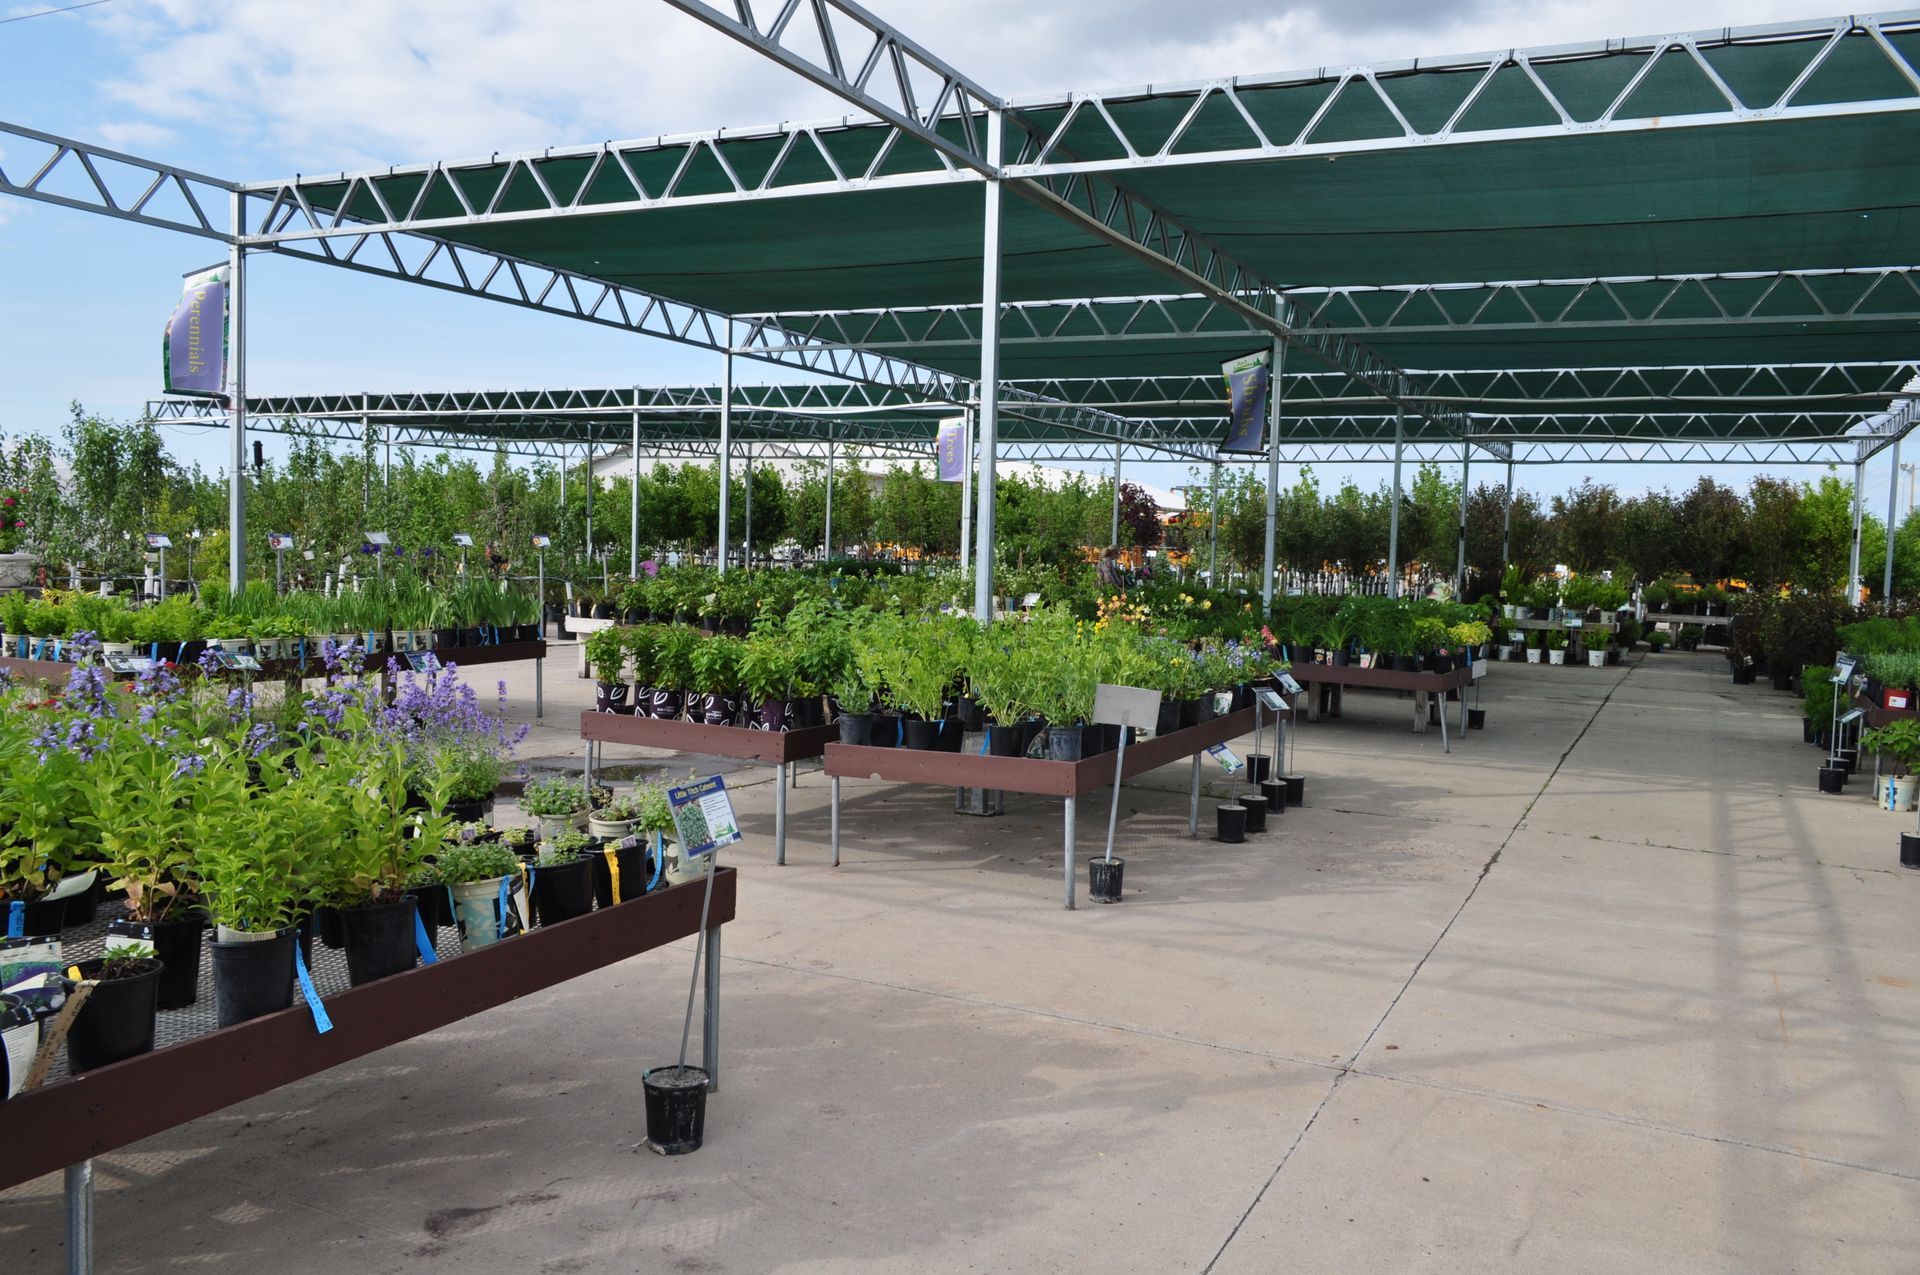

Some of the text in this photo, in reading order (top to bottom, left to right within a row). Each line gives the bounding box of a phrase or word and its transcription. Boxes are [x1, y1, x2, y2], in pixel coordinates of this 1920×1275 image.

[188, 290, 206, 375] Perennials
[1237, 374, 1258, 437] Shrubs
[946, 433, 957, 464] Trees
